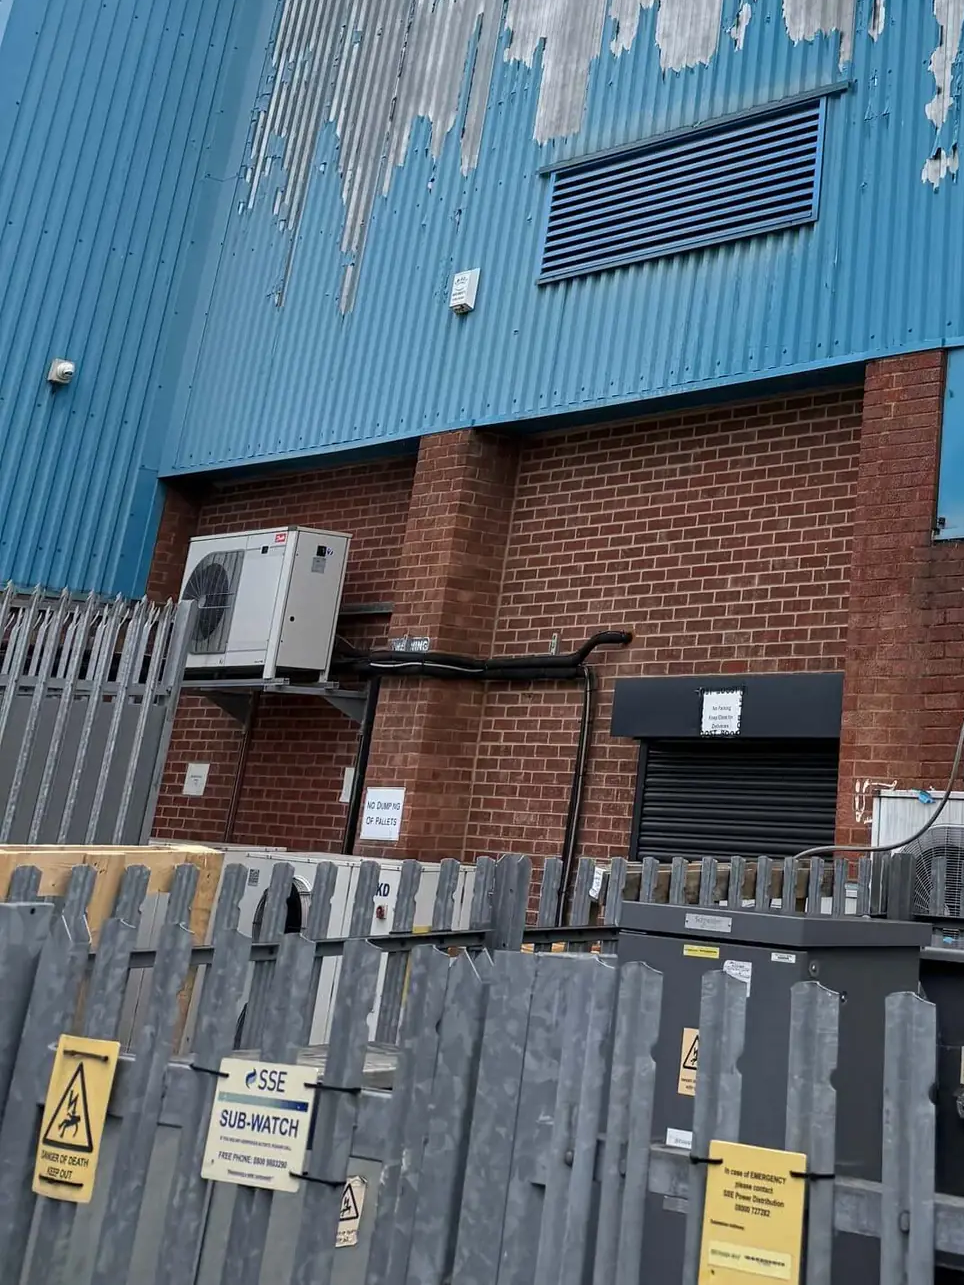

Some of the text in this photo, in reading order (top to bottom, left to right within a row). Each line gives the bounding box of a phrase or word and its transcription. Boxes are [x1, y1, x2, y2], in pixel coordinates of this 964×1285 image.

[258, 1069, 288, 1093] SSE
[219, 1109, 300, 1139] SUB-WATCH
[60, 1154, 68, 1165] OF
[68, 1156, 89, 1168] DEATH
[218, 1151, 234, 1161] FREE
[47, 1166, 73, 1180] KEEP OUT
[750, 1171, 786, 1185] EMERGENCY
